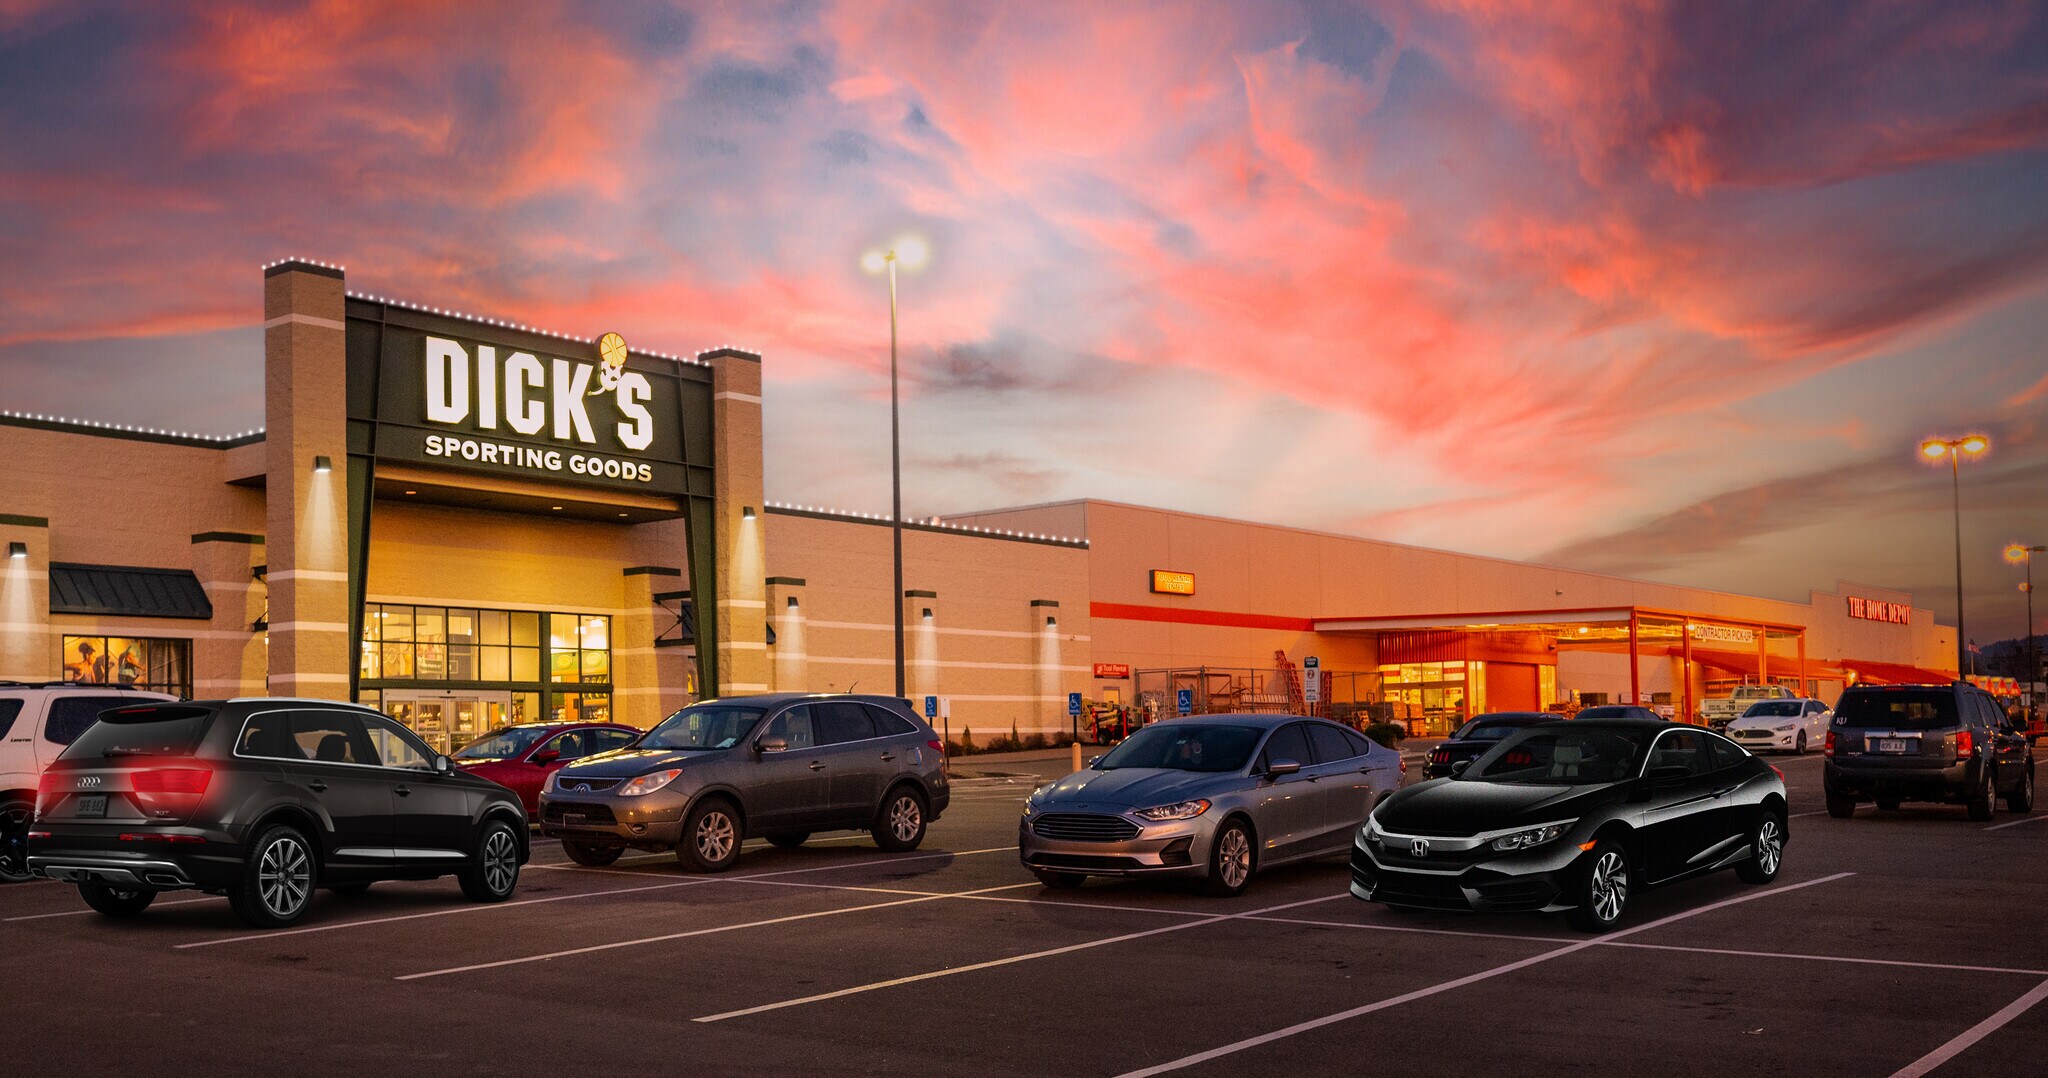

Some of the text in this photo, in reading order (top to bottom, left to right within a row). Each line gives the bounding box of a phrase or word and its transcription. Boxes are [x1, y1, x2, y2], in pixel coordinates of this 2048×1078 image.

[425, 435, 652, 482] SPORTING GOODS
[1848, 597, 1911, 624] THE HOME DEPOT
[1695, 625, 1731, 640] CONTRACTOR
[1103, 664, 1127, 673] Tool Rental
